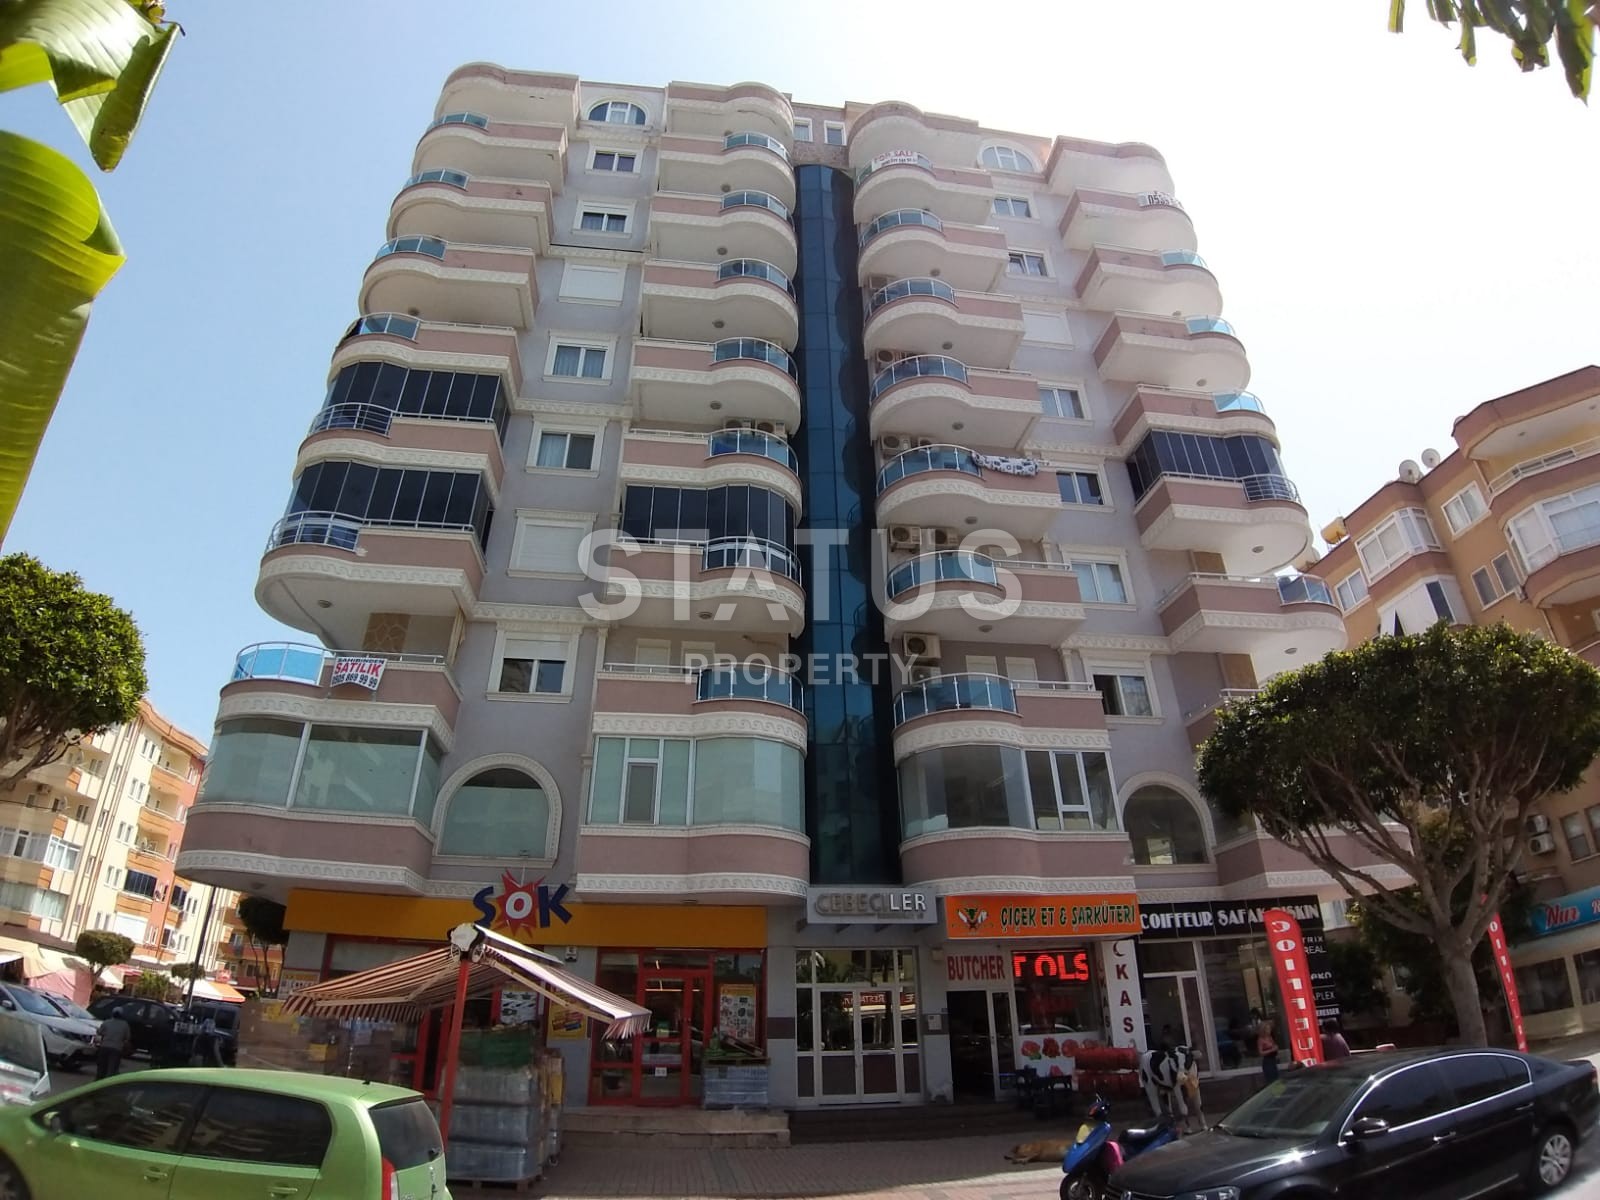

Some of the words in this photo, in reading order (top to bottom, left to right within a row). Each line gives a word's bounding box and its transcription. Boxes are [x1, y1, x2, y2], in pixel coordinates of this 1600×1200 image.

[335, 662, 382, 678] SATILIK
[1040, 907, 1055, 926] ET
[1140, 910, 1214, 930] COIFFEUR
[947, 955, 1006, 981] BUTCHER
